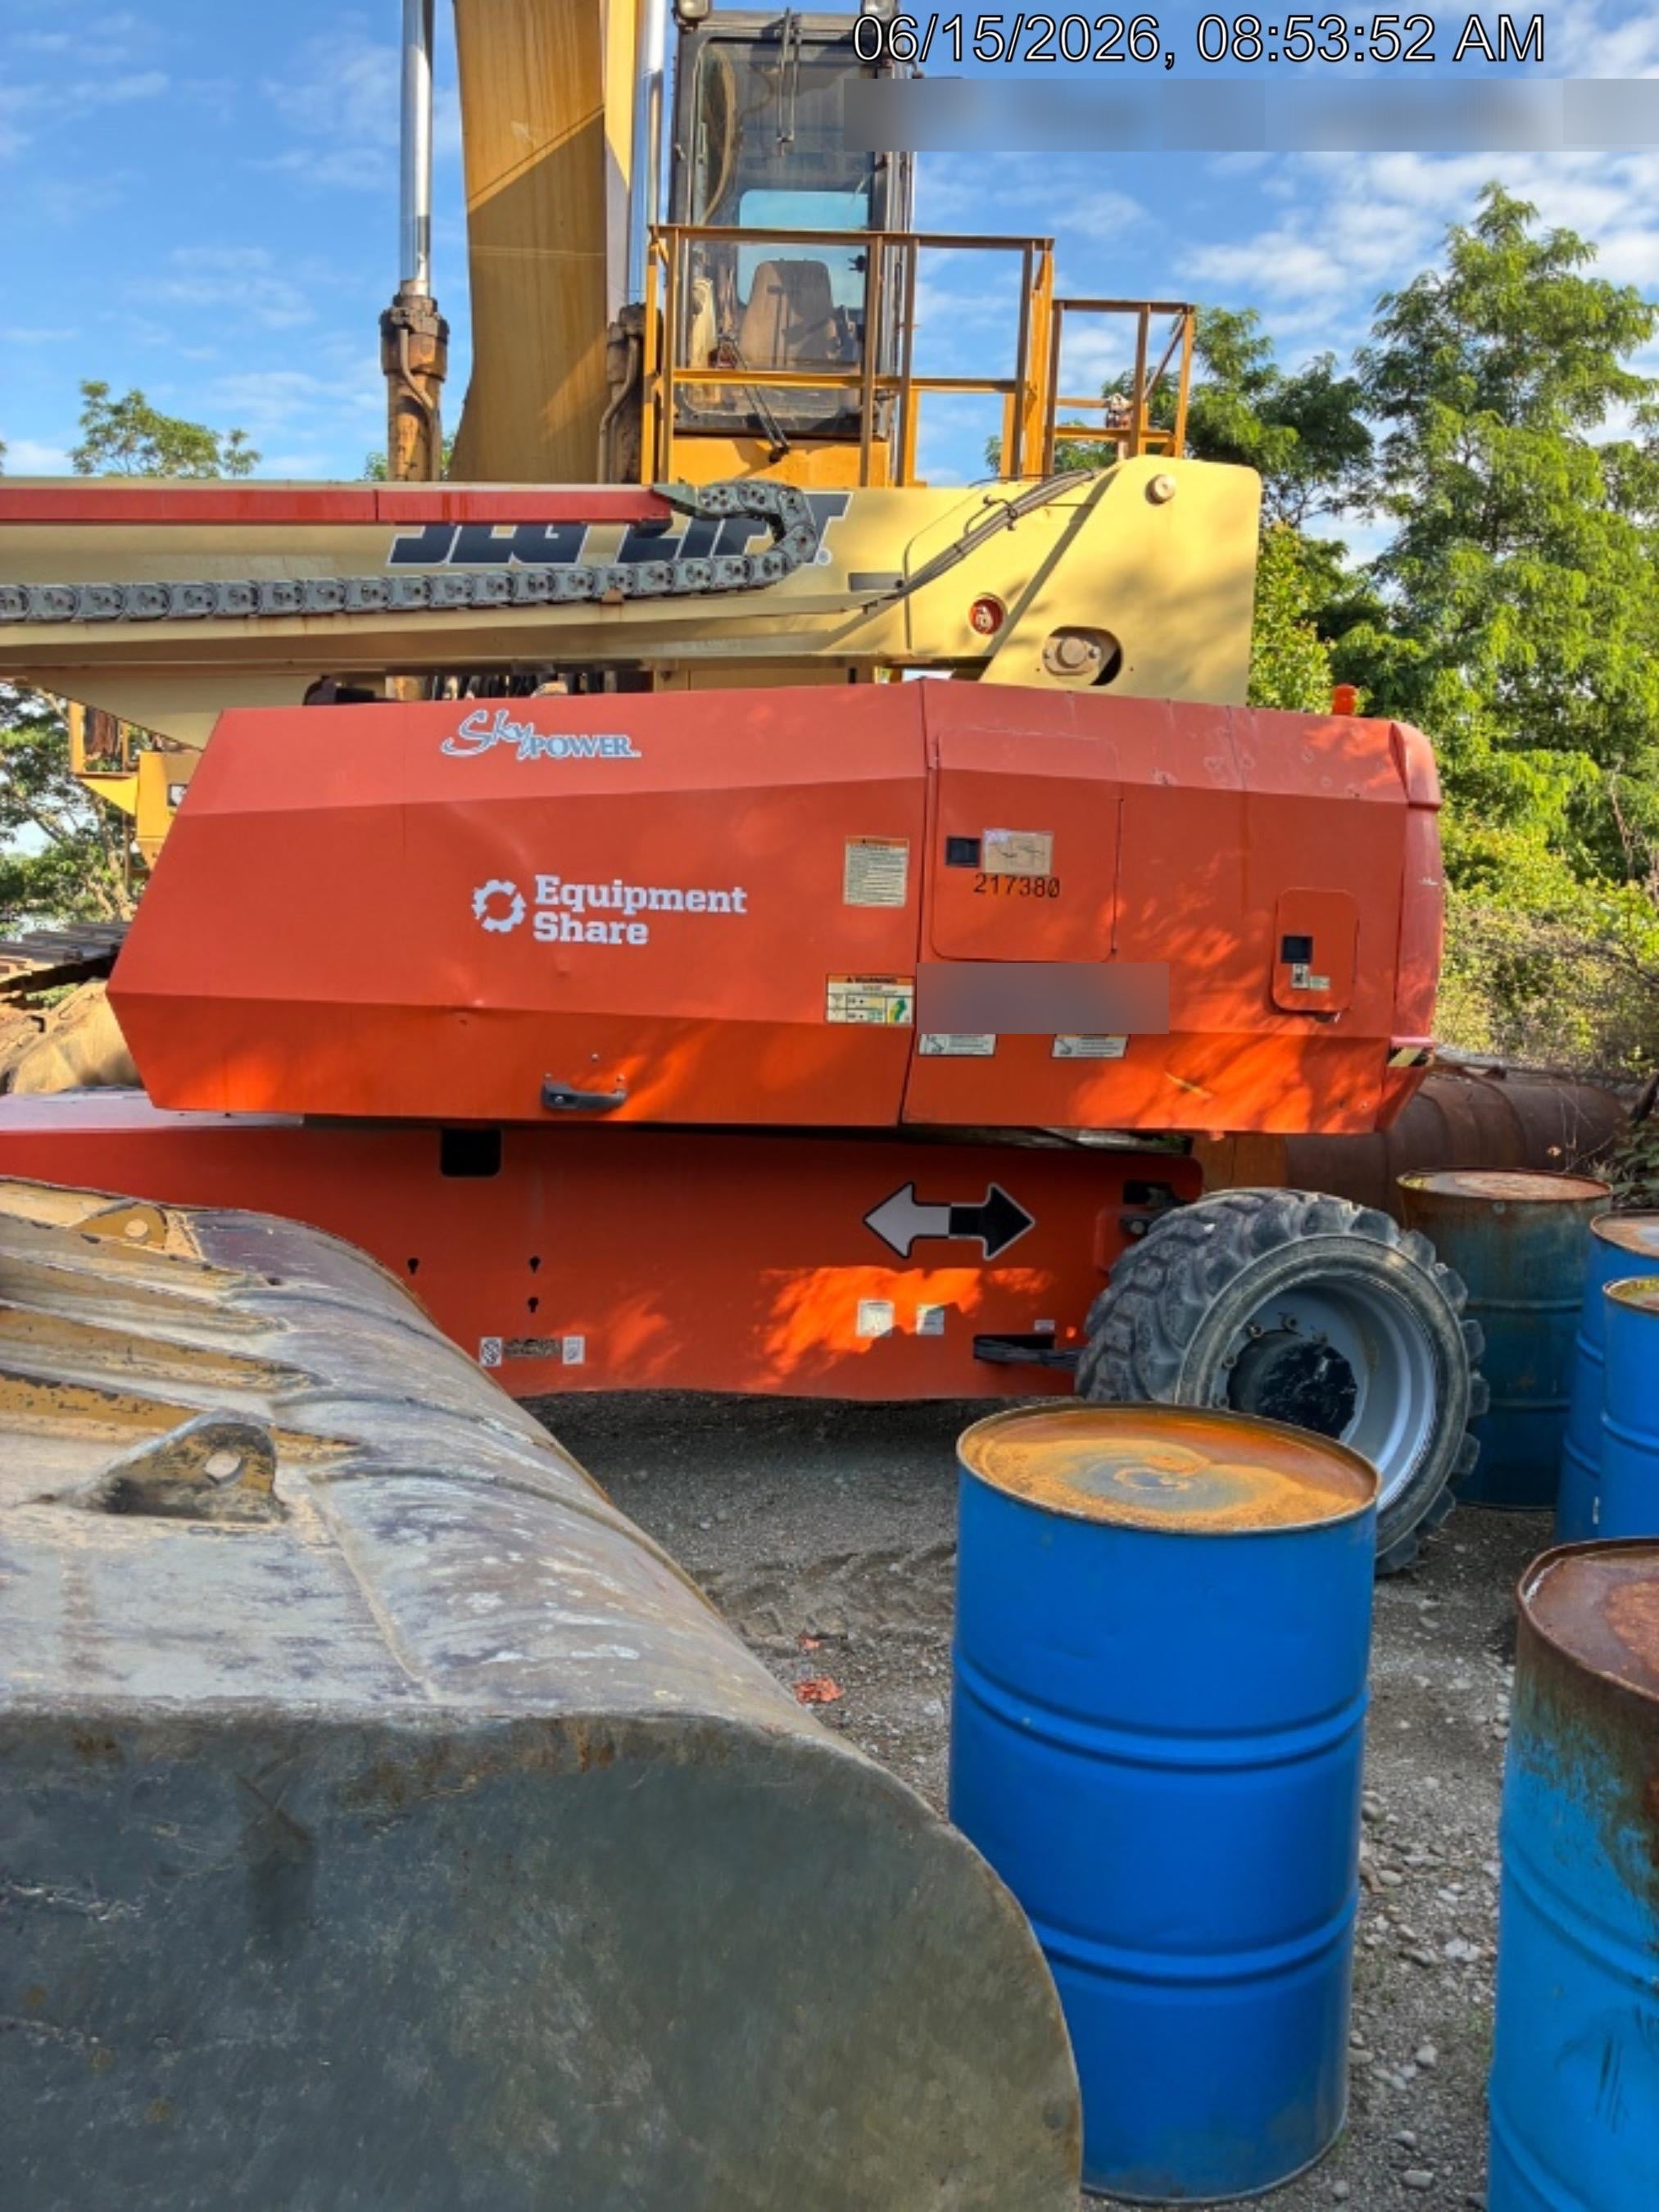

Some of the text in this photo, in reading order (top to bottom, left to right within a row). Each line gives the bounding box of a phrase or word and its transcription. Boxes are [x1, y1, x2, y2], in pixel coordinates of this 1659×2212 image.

[534, 874, 747, 915] Equipment
[972, 873, 1061, 899] 217380
[533, 911, 649, 945] Share
